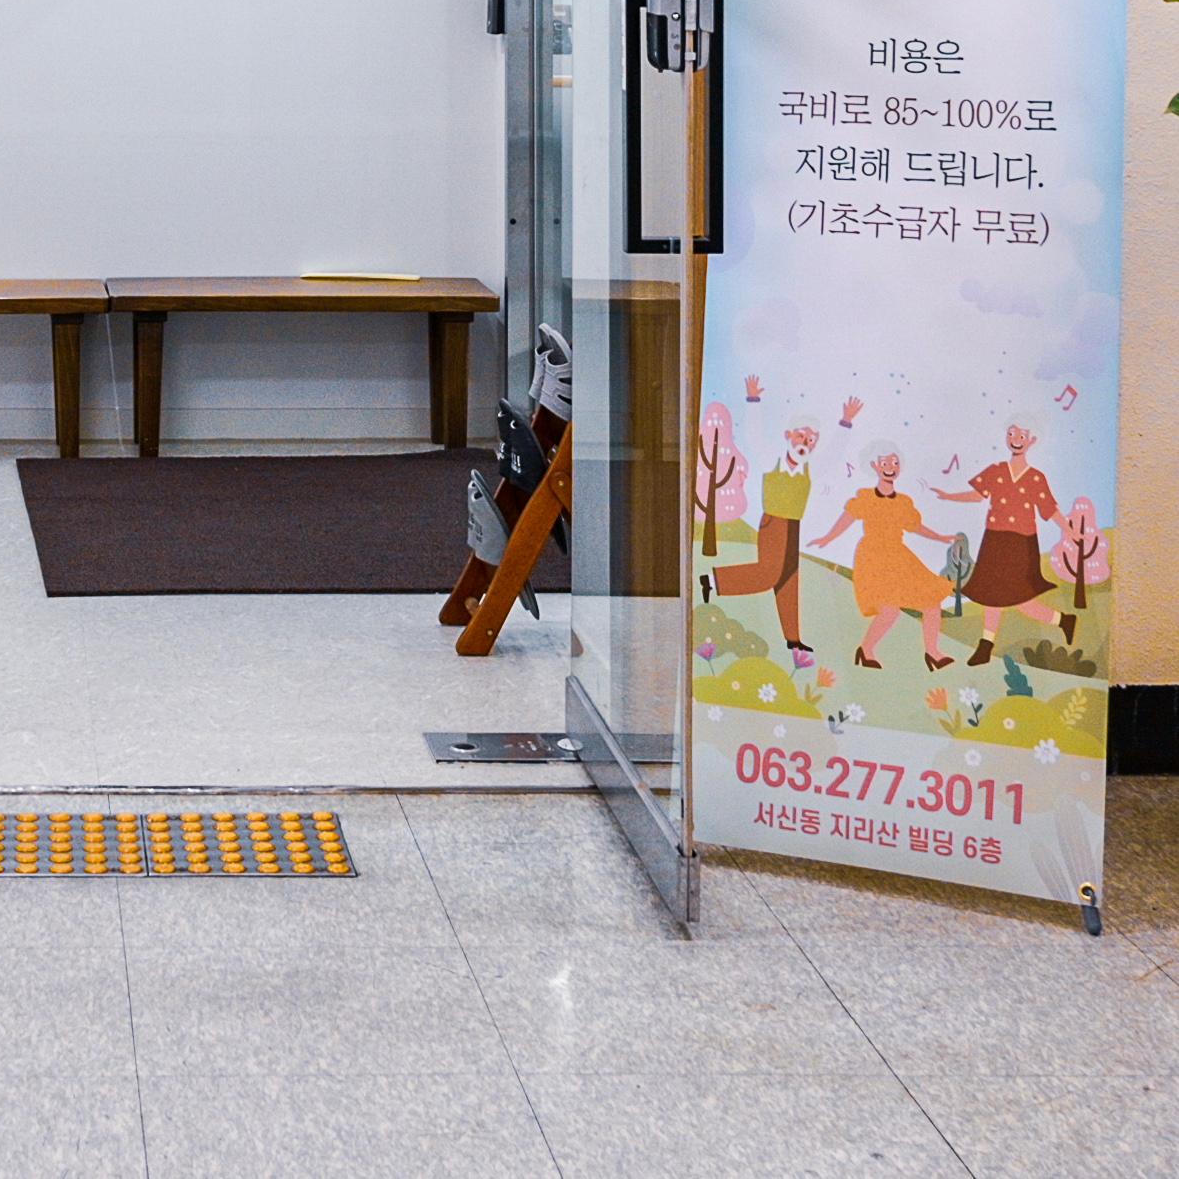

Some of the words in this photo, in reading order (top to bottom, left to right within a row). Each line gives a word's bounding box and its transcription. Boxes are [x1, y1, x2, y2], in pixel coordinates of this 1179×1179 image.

[868, 37, 965, 75] 비용은
[778, 90, 873, 126] 국비로
[883, 96, 1058, 132] 85~100%로
[795, 144, 891, 184] 지원해
[903, 150, 1045, 190] 드립니다.
[787, 199, 962, 243] (기초수급자
[972, 209, 1051, 247] 무료)
[735, 742, 1024, 825] 063.277.3011
[753, 801, 821, 836] 서신동
[829, 813, 901, 849] 지리산
[908, 825, 954, 858] 빌딩
[962, 835, 1003, 865] 6층
